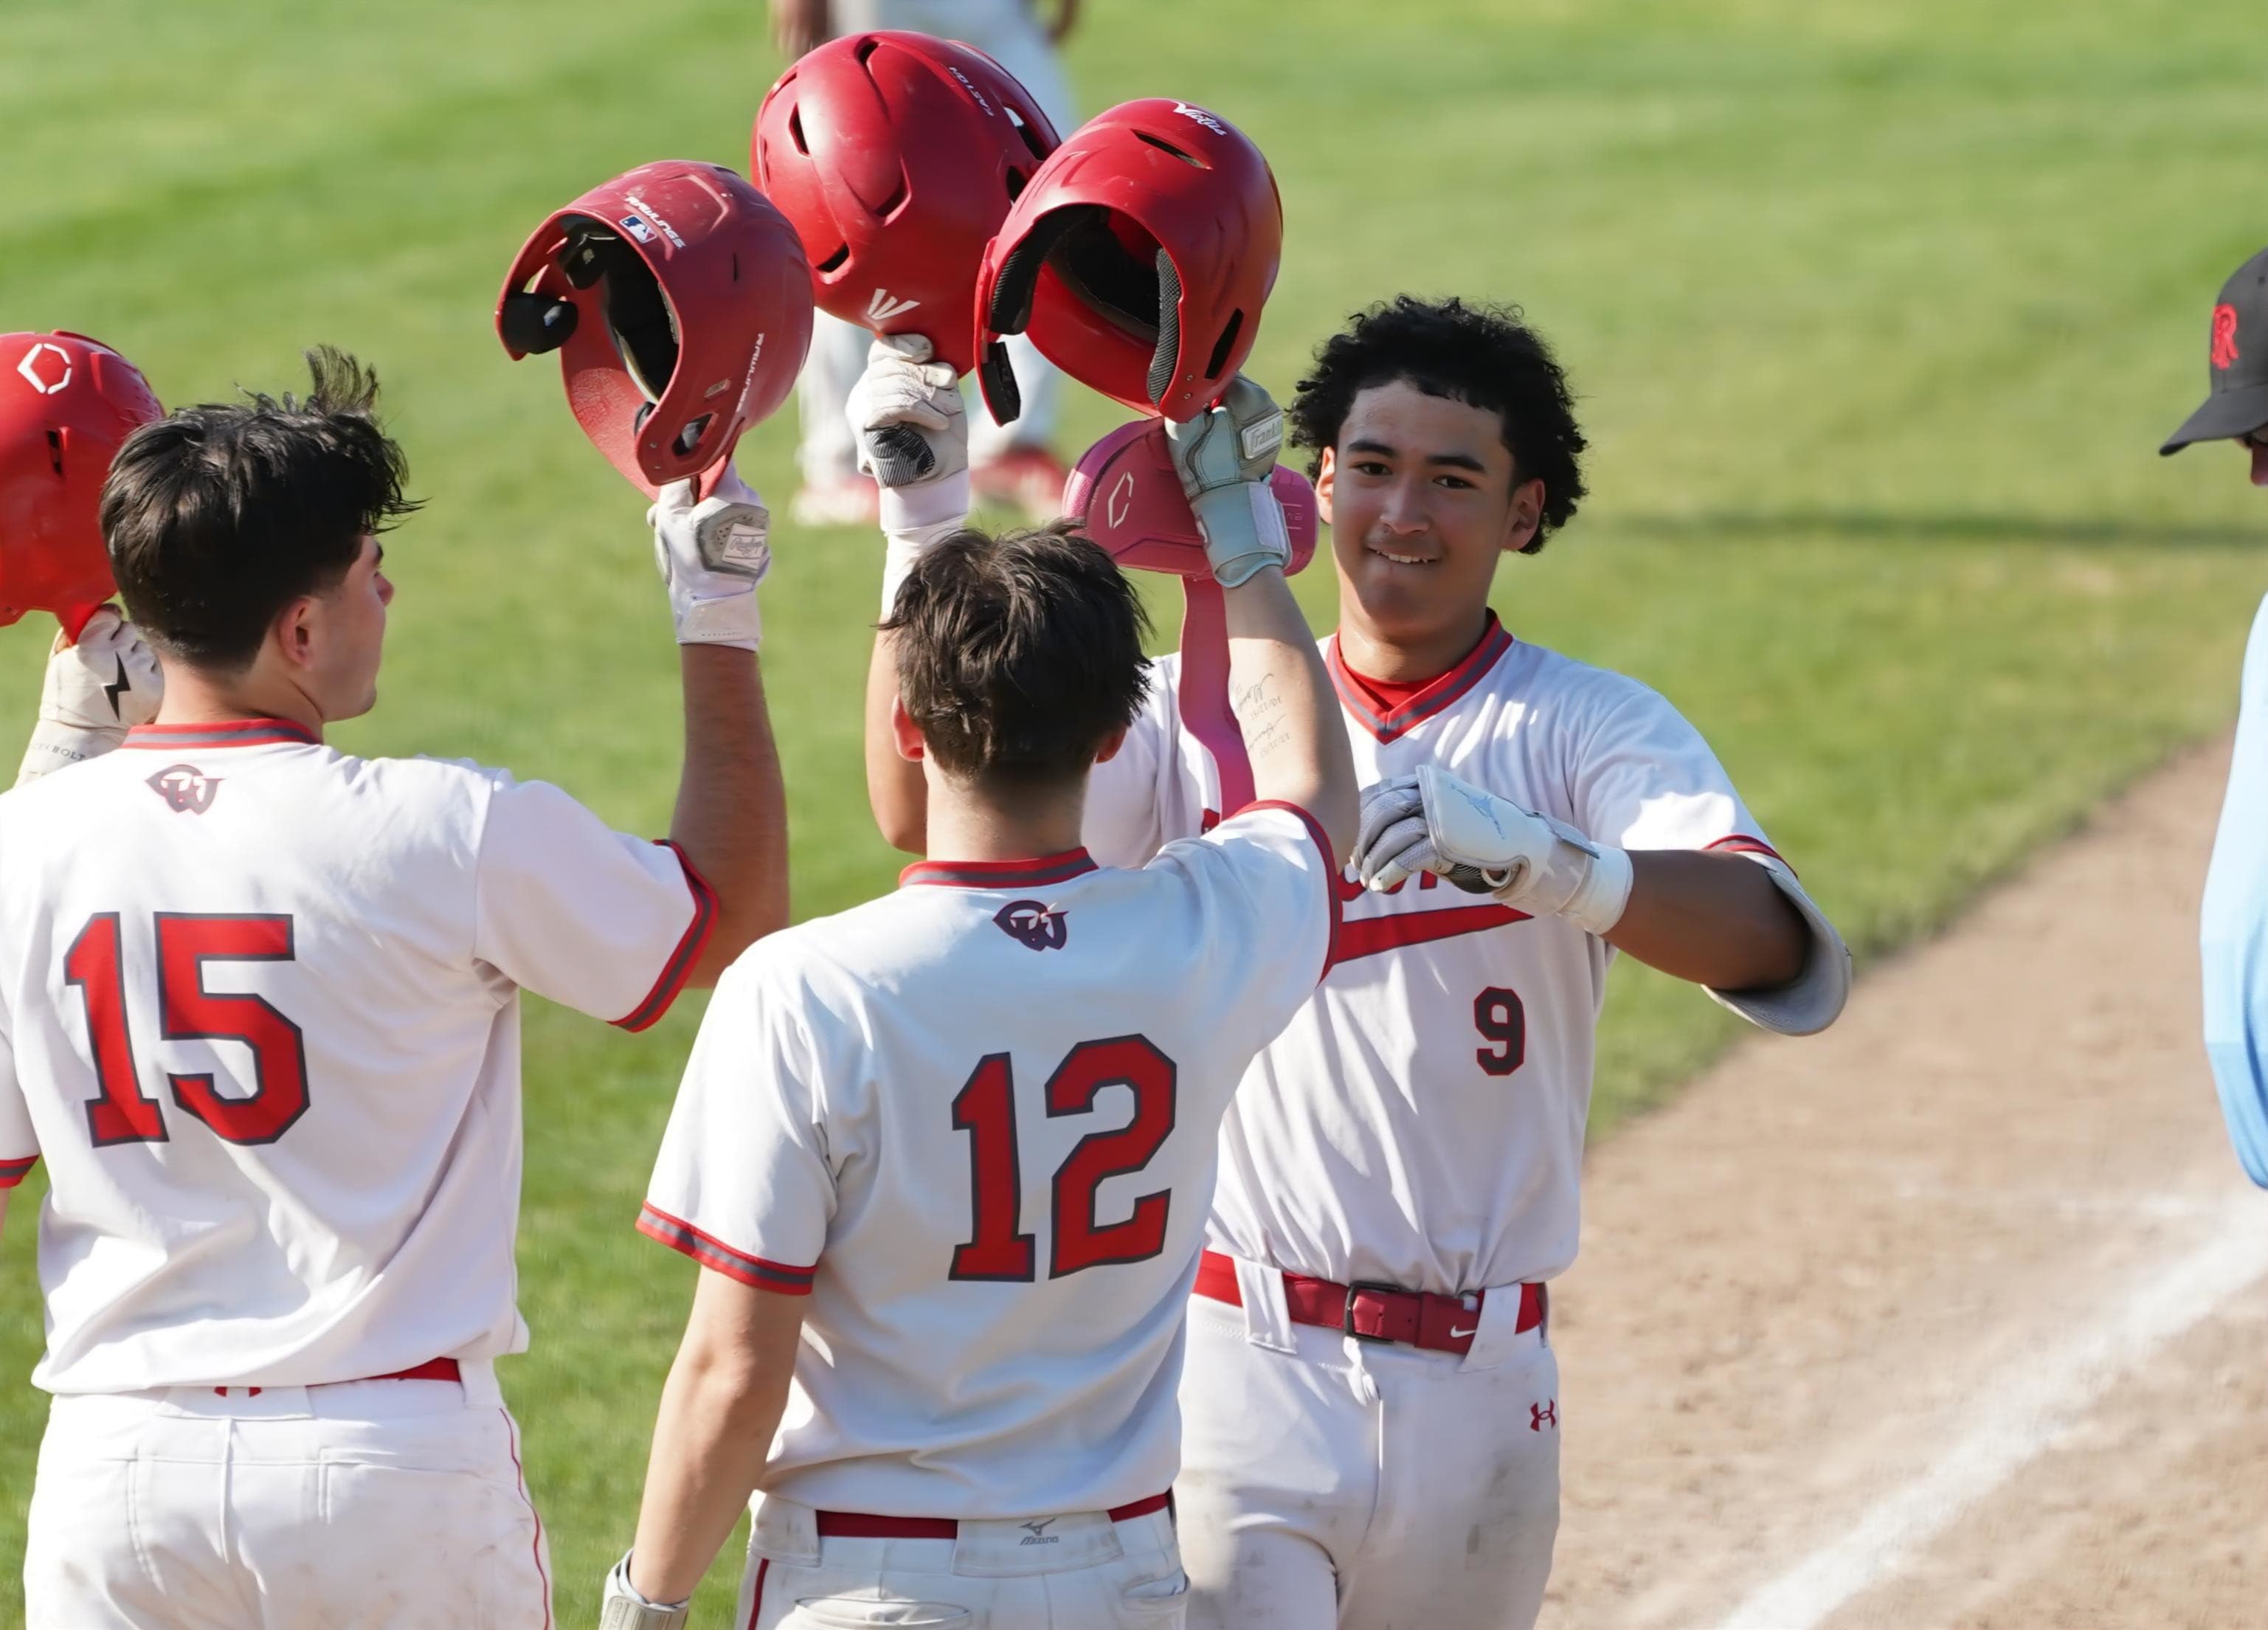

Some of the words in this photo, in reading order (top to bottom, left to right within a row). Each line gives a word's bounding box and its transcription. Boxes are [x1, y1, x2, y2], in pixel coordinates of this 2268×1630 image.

[52, 745, 86, 762] BOLT
[63, 911, 311, 1148] 15
[1473, 986, 1525, 1076] 9
[948, 1033, 1177, 1283] 12
